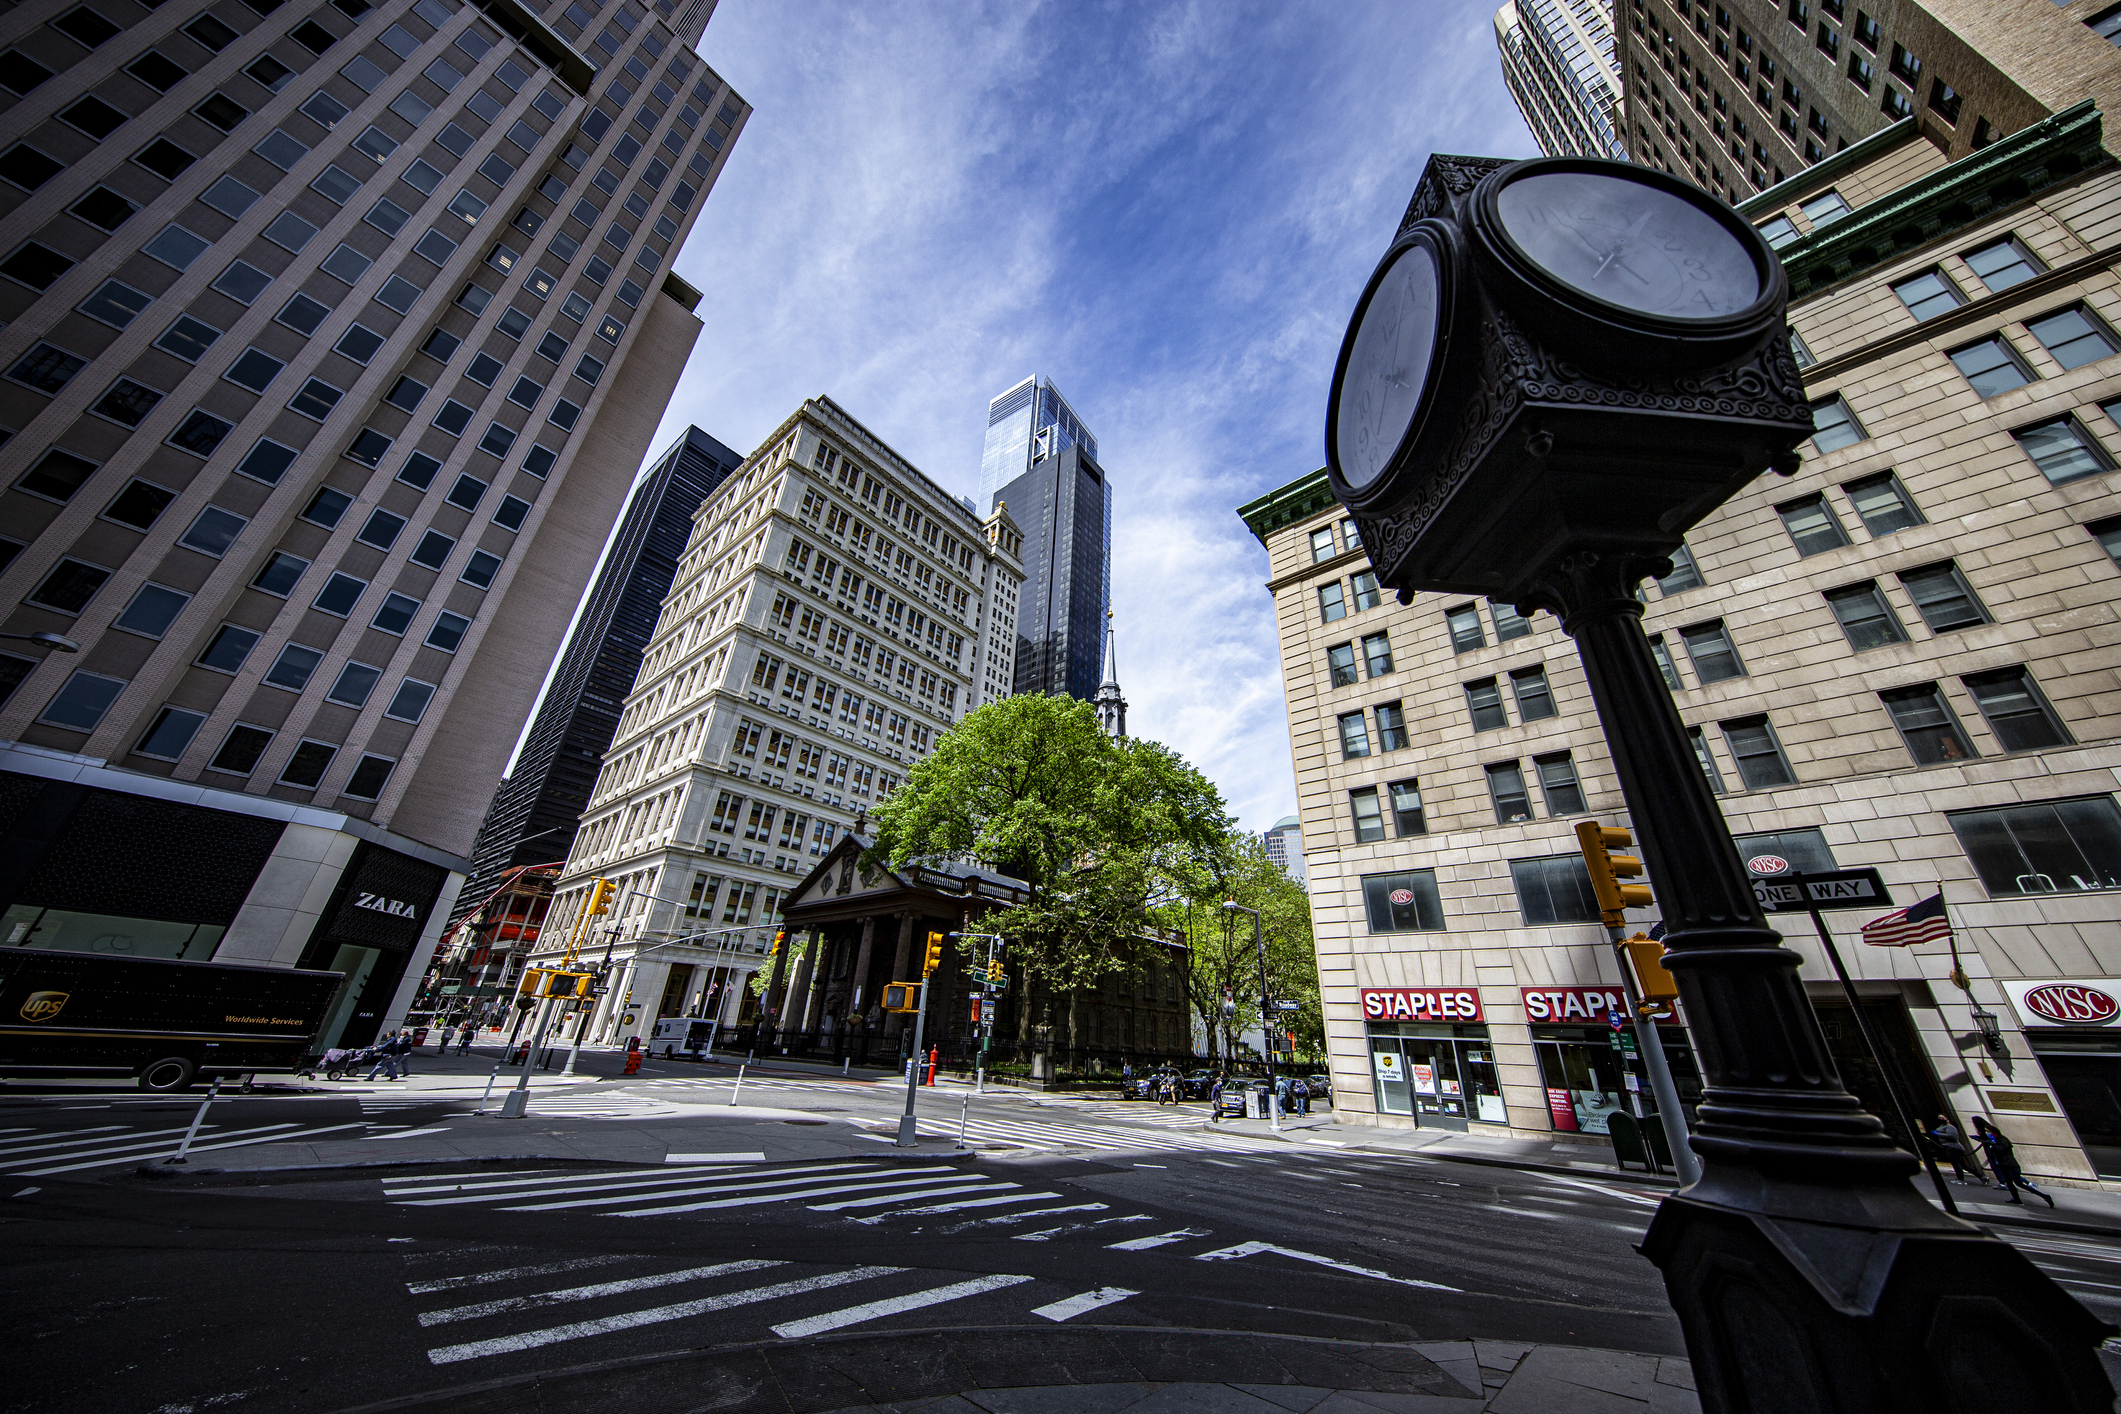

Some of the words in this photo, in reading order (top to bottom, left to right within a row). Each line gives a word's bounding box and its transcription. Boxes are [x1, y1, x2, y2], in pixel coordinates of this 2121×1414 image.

[1683, 257, 1713, 282] 3
[1358, 426, 1370, 454] 9
[1368, 446, 1381, 474] 8
[1751, 857, 1784, 873] NYSC
[1755, 886, 1797, 903] ONE
[1812, 880, 1860, 898] WAY
[354, 892, 416, 919] ZARA
[24, 1000, 62, 1018] ups
[1364, 992, 1477, 1018] STAPLES
[1525, 991, 1672, 1019] STAPL
[2032, 986, 2110, 1020] NYSC
[225, 1015, 269, 1025] Worldwide
[270, 1017, 304, 1026] Services
